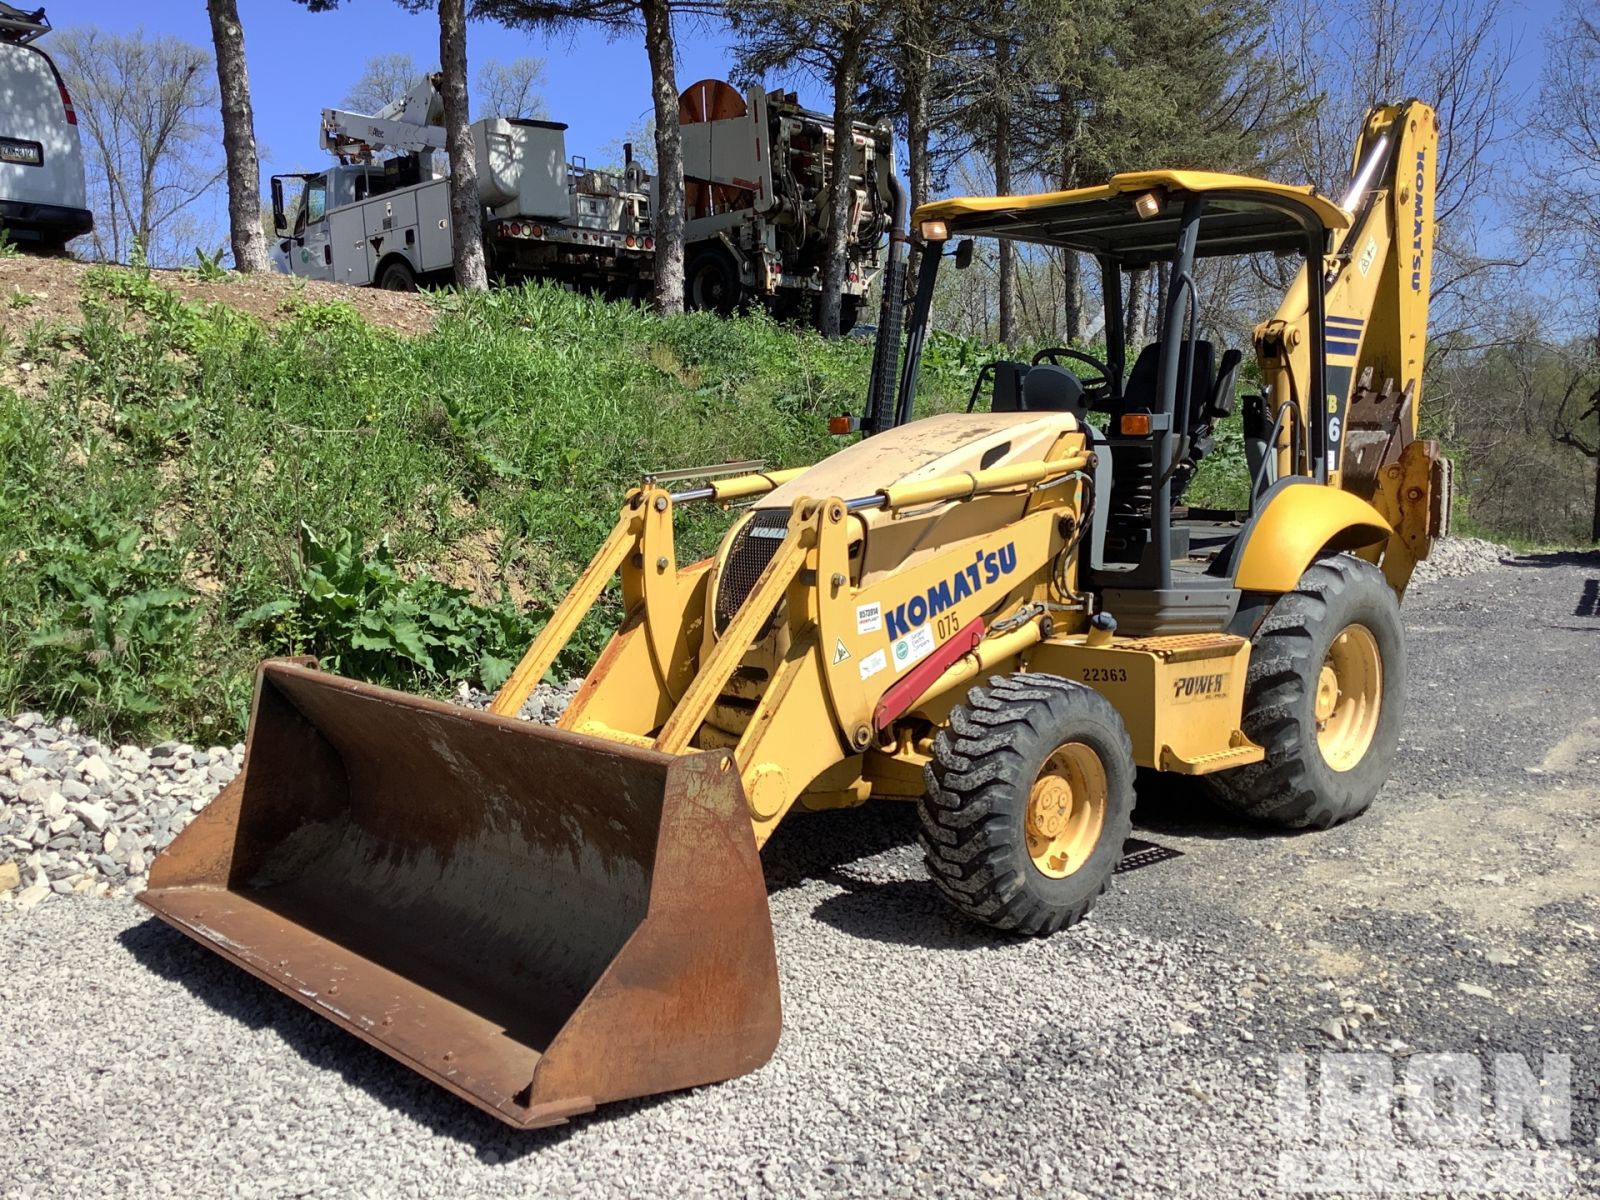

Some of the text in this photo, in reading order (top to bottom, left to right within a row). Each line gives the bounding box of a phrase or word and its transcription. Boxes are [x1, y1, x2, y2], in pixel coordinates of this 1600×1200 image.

[1411, 151, 1425, 291] KOMATSU
[1326, 394, 1338, 414] B
[749, 527, 788, 539] KOMA
[884, 541, 1017, 642] KOMATSU
[937, 611, 960, 640] 075
[1082, 668, 1128, 682] 22363
[1173, 674, 1223, 699] POWER
